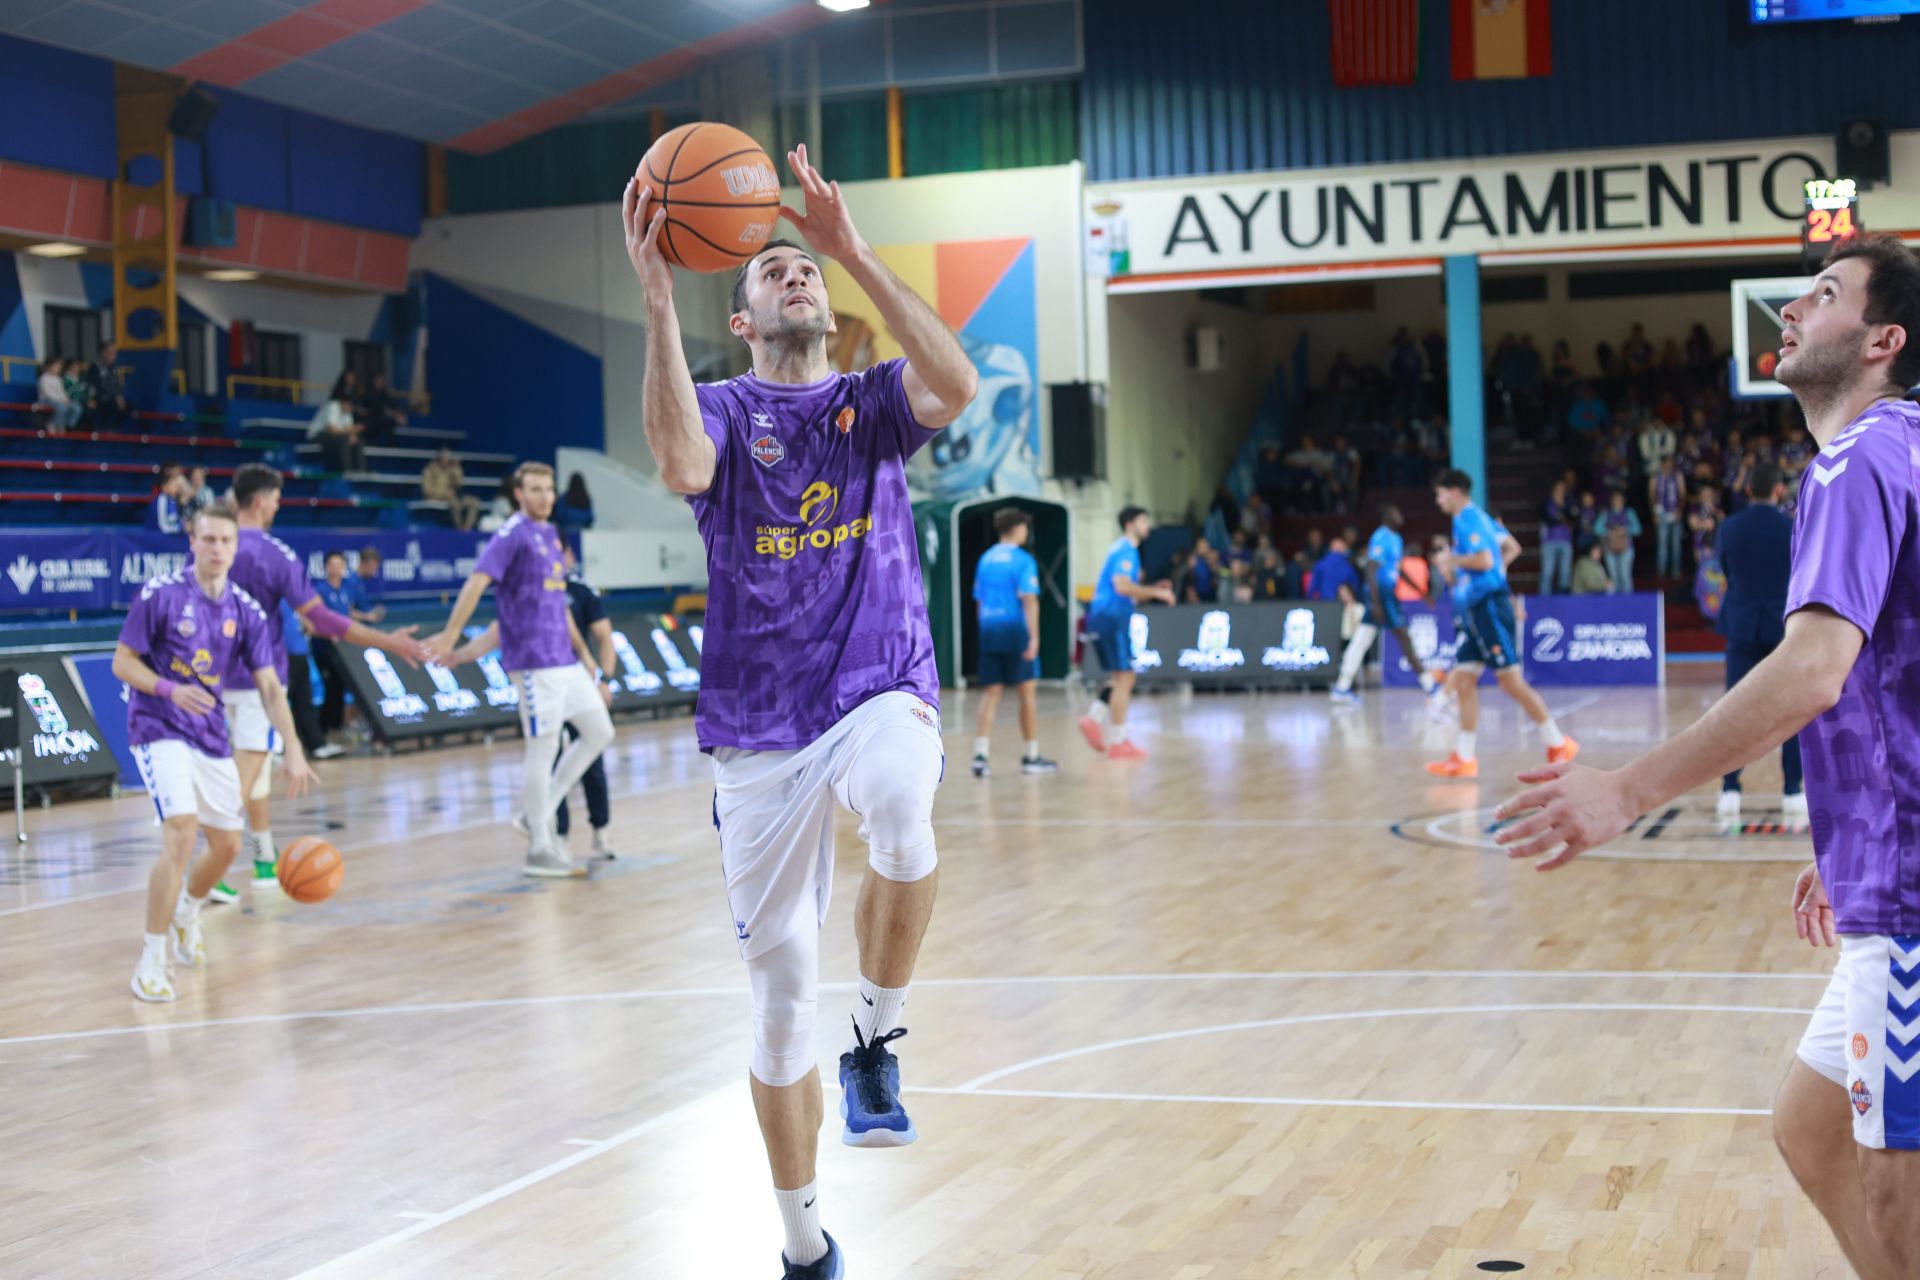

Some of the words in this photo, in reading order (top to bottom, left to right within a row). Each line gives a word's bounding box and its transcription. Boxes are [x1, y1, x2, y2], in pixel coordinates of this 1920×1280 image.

[1164, 152, 1827, 257] AYUNTAMIENTO
[1808, 208, 1856, 242] 24
[755, 508, 872, 560] agropal
[756, 525, 797, 537] súper
[1567, 639, 1653, 662] ZAMORA
